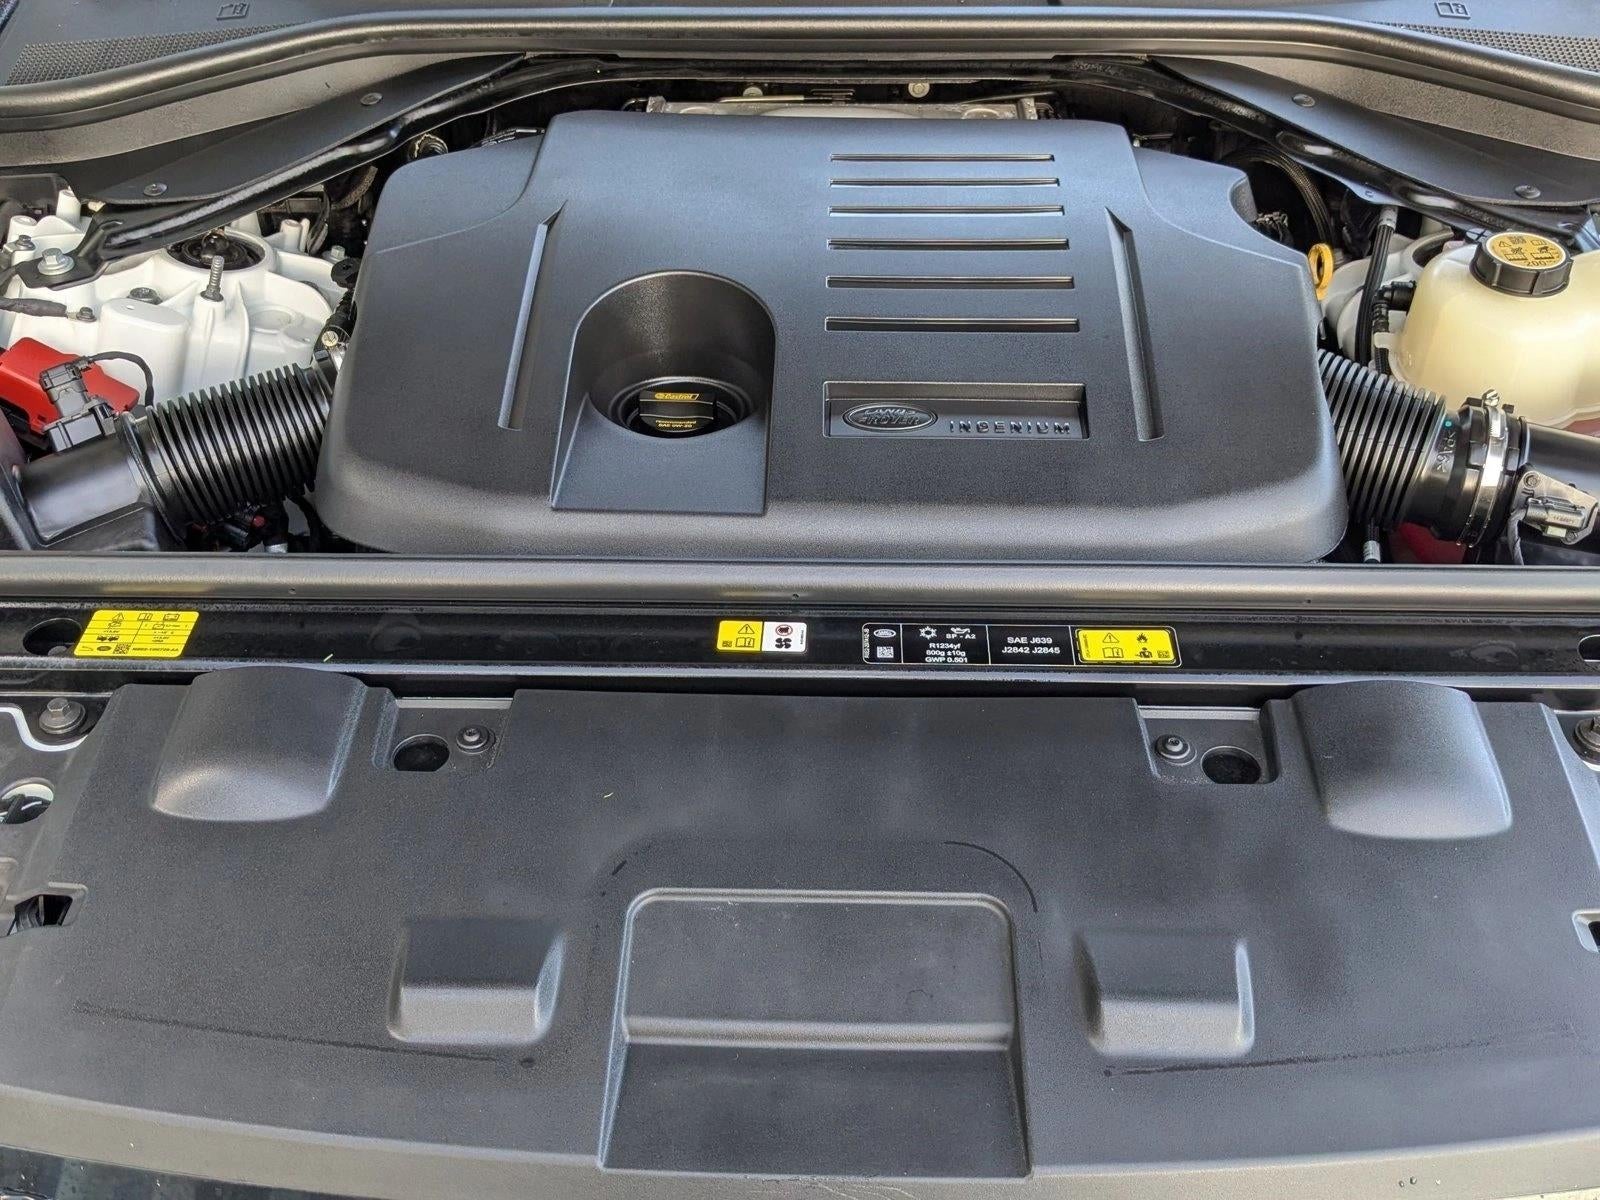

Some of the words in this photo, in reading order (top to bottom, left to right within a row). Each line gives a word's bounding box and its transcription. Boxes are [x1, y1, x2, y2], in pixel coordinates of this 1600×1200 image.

[664, 392, 694, 400] Castrol
[859, 415, 921, 426] ROVER
[950, 420, 1070, 434] INGENIUM
[1007, 636, 1027, 644] SAE
[1029, 637, 1053, 645] J639
[929, 642, 961, 650] R1234yf
[1002, 645, 1030, 654] J2842
[1031, 646, 1060, 654] J2845
